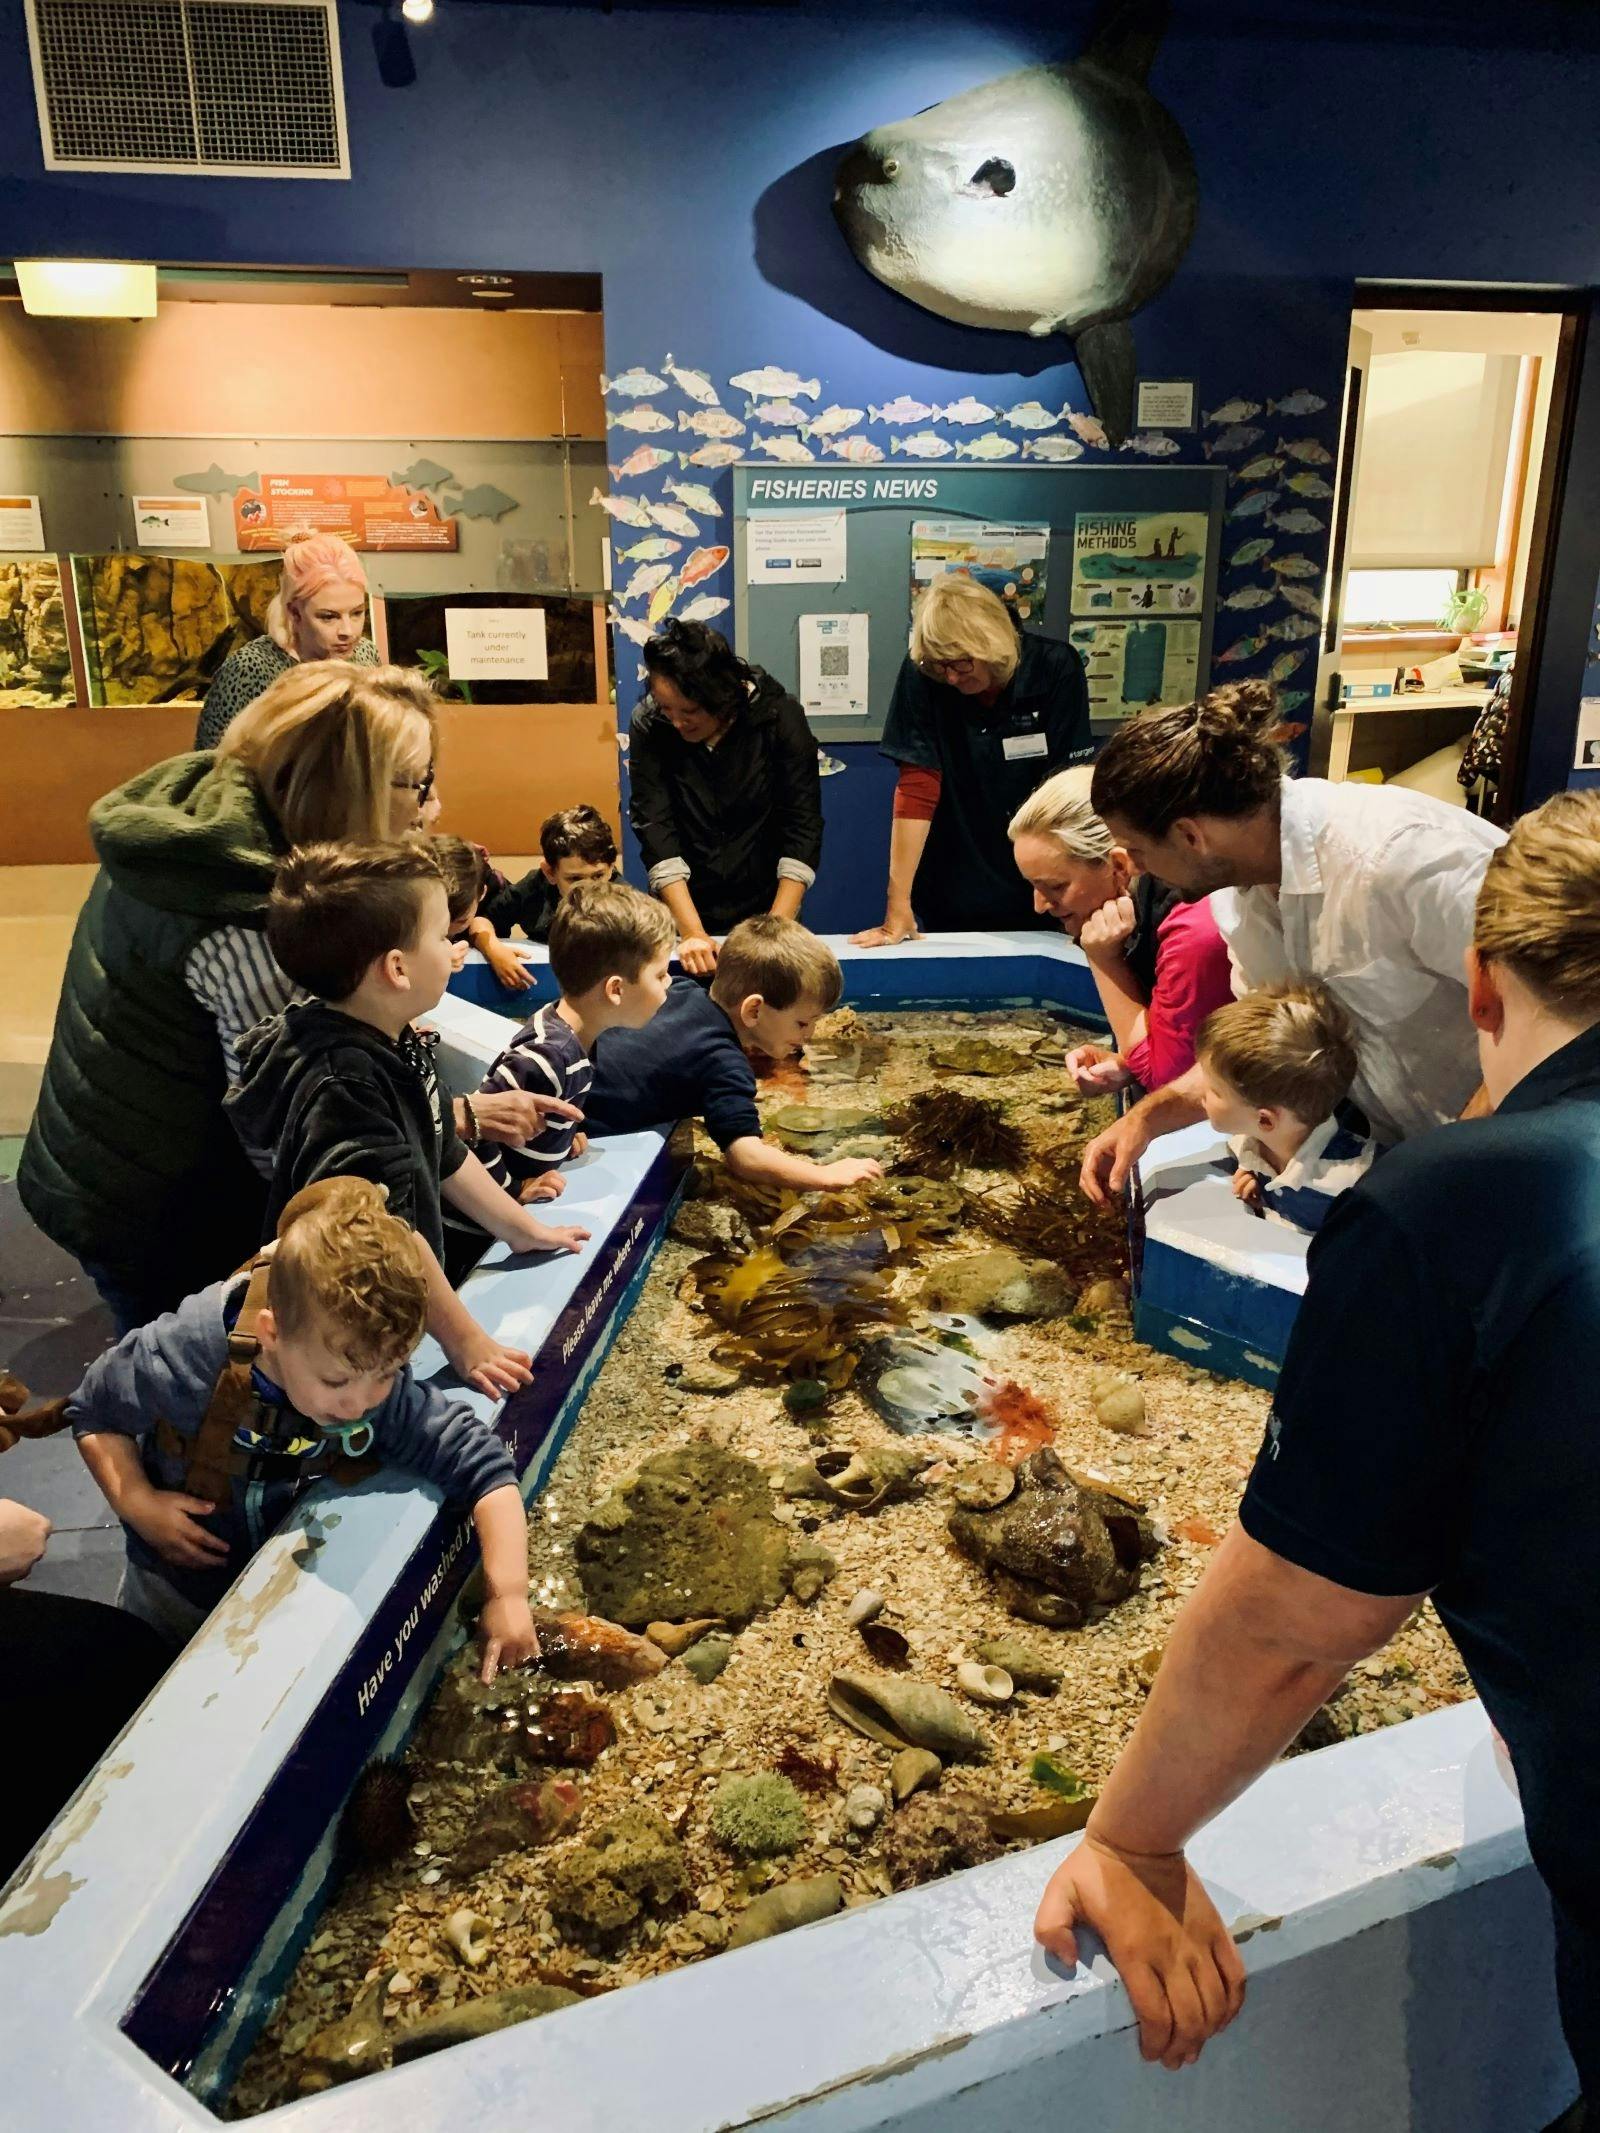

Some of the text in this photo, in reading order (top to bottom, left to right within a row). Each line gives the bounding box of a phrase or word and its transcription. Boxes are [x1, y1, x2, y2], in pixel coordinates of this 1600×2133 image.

[751, 478, 939, 499] FISHERIES NEWS
[1077, 520, 1137, 536] FISHING
[1077, 537, 1137, 549] METHODS
[466, 630, 526, 640] Tank currently
[470, 656, 526, 664] maintenance
[562, 1318, 585, 1364] Please
[585, 1288, 603, 1320] leave
[603, 1270, 613, 1293] me
[613, 1240, 631, 1275] where
[630, 1229, 634, 1245] I
[357, 1647, 393, 1716] Have
[394, 1606, 419, 1662] you
[419, 1524, 463, 1611] washed
